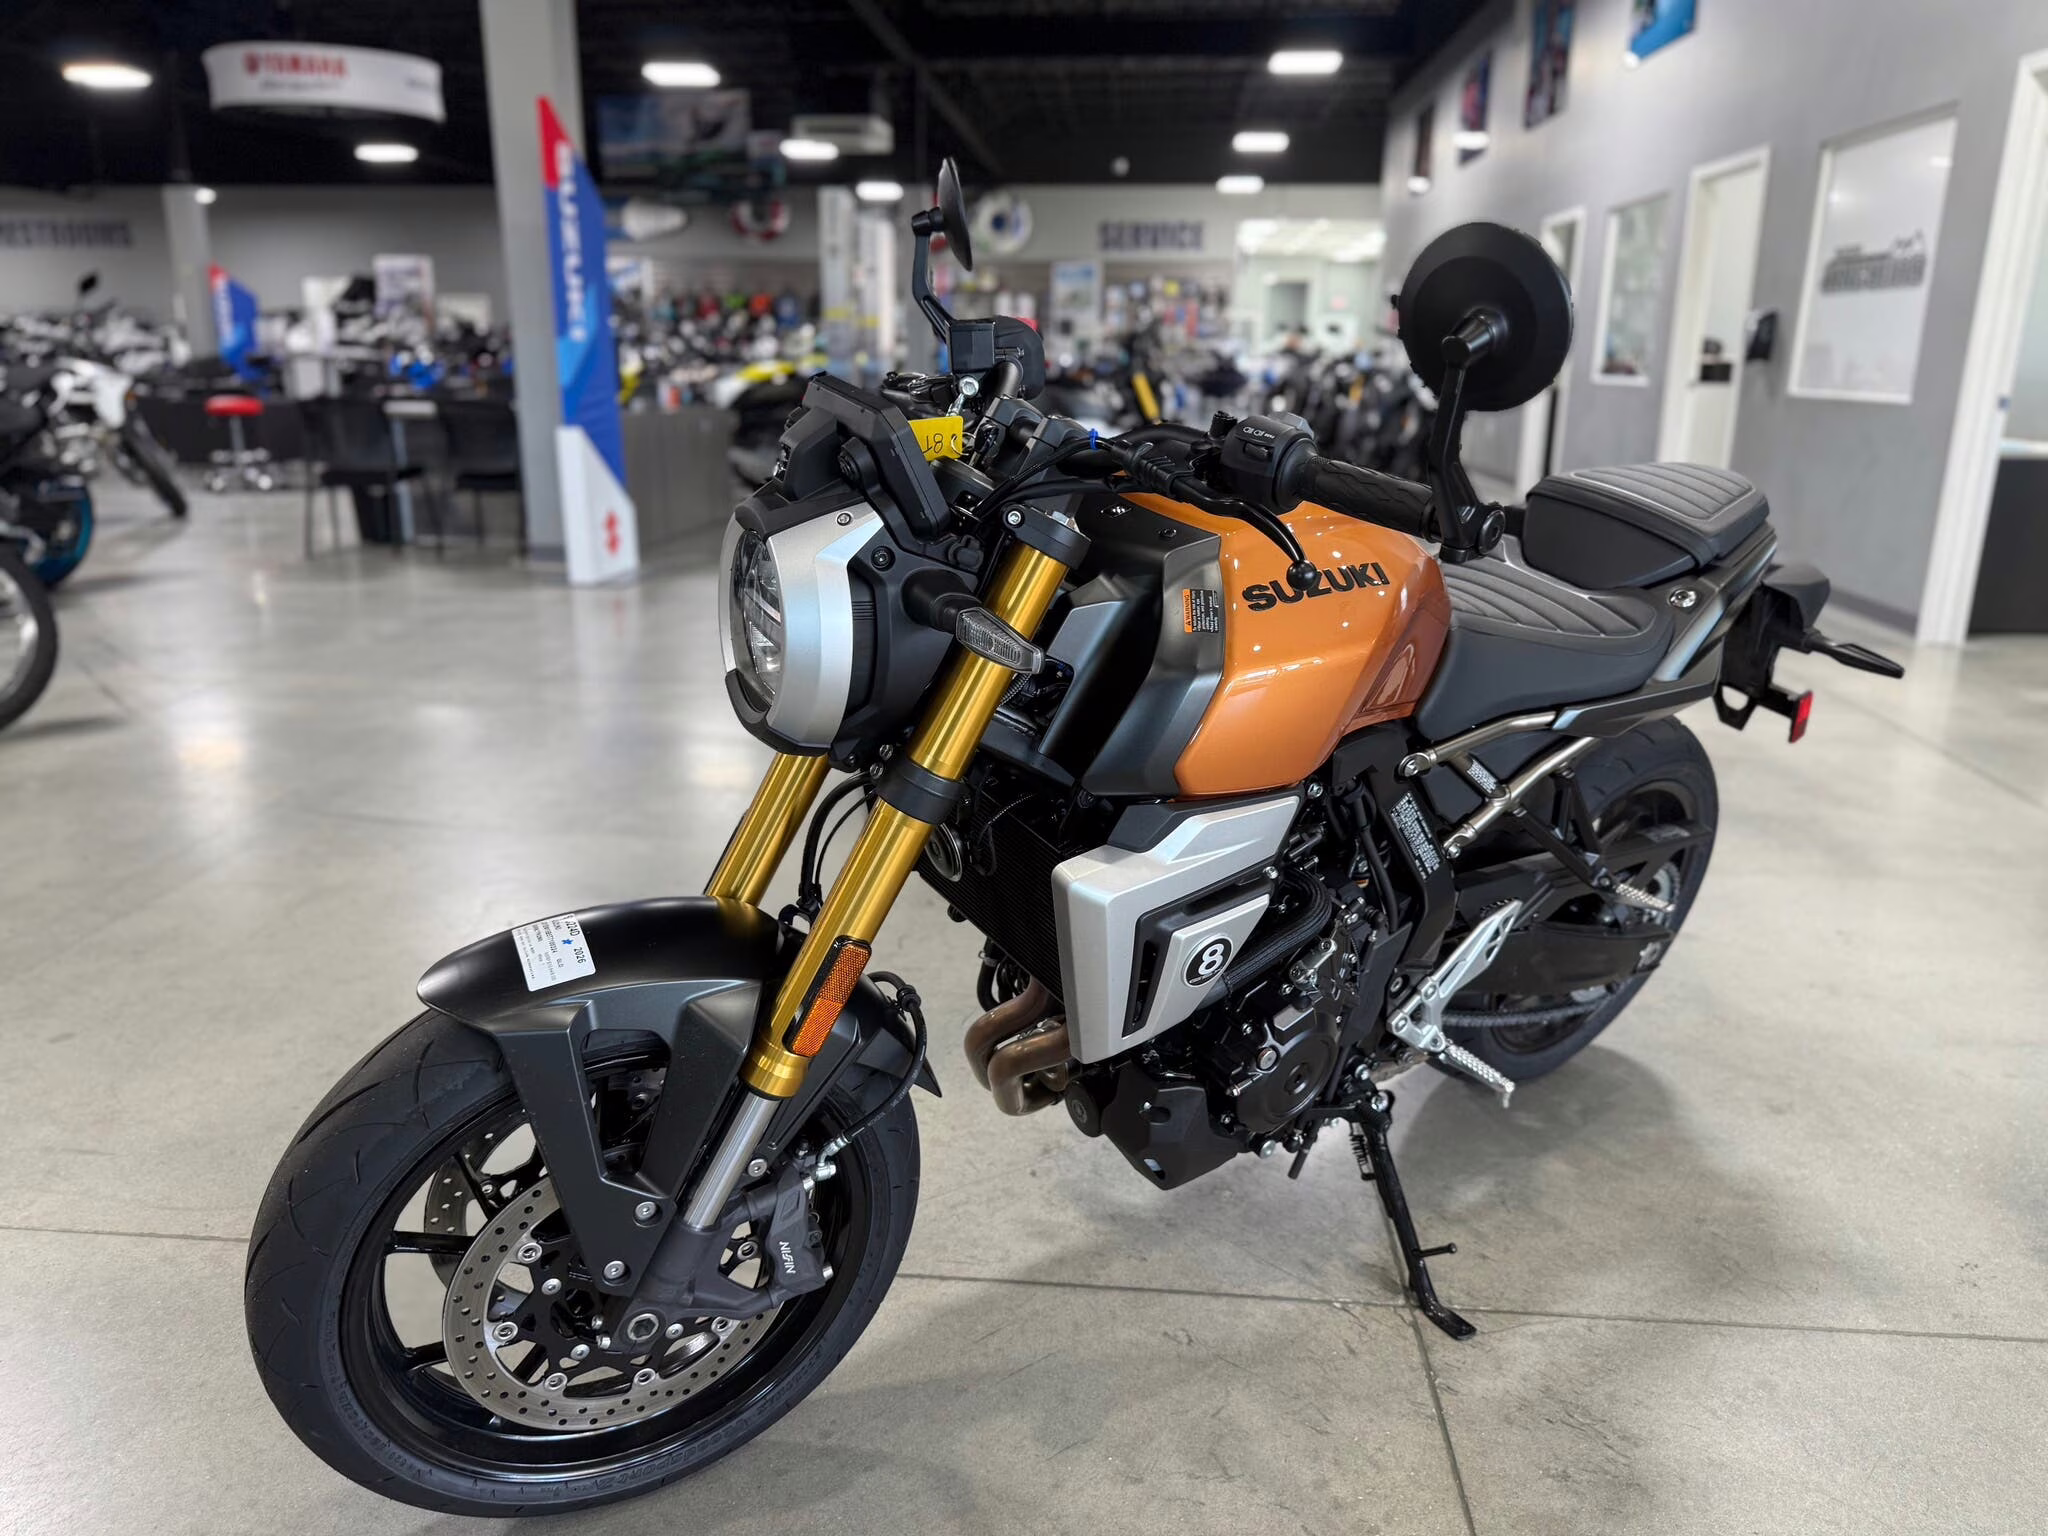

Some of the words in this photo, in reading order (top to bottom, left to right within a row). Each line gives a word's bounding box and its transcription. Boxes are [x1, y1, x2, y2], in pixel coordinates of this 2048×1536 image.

[0, 220, 132, 249] ESTROOMS
[1098, 221, 1204, 250] SERVICE
[1242, 562, 1390, 612] SUZUKI
[574, 947, 587, 964] 2026
[1198, 944, 1224, 975] 8
[779, 1241, 797, 1274] NISSIN
